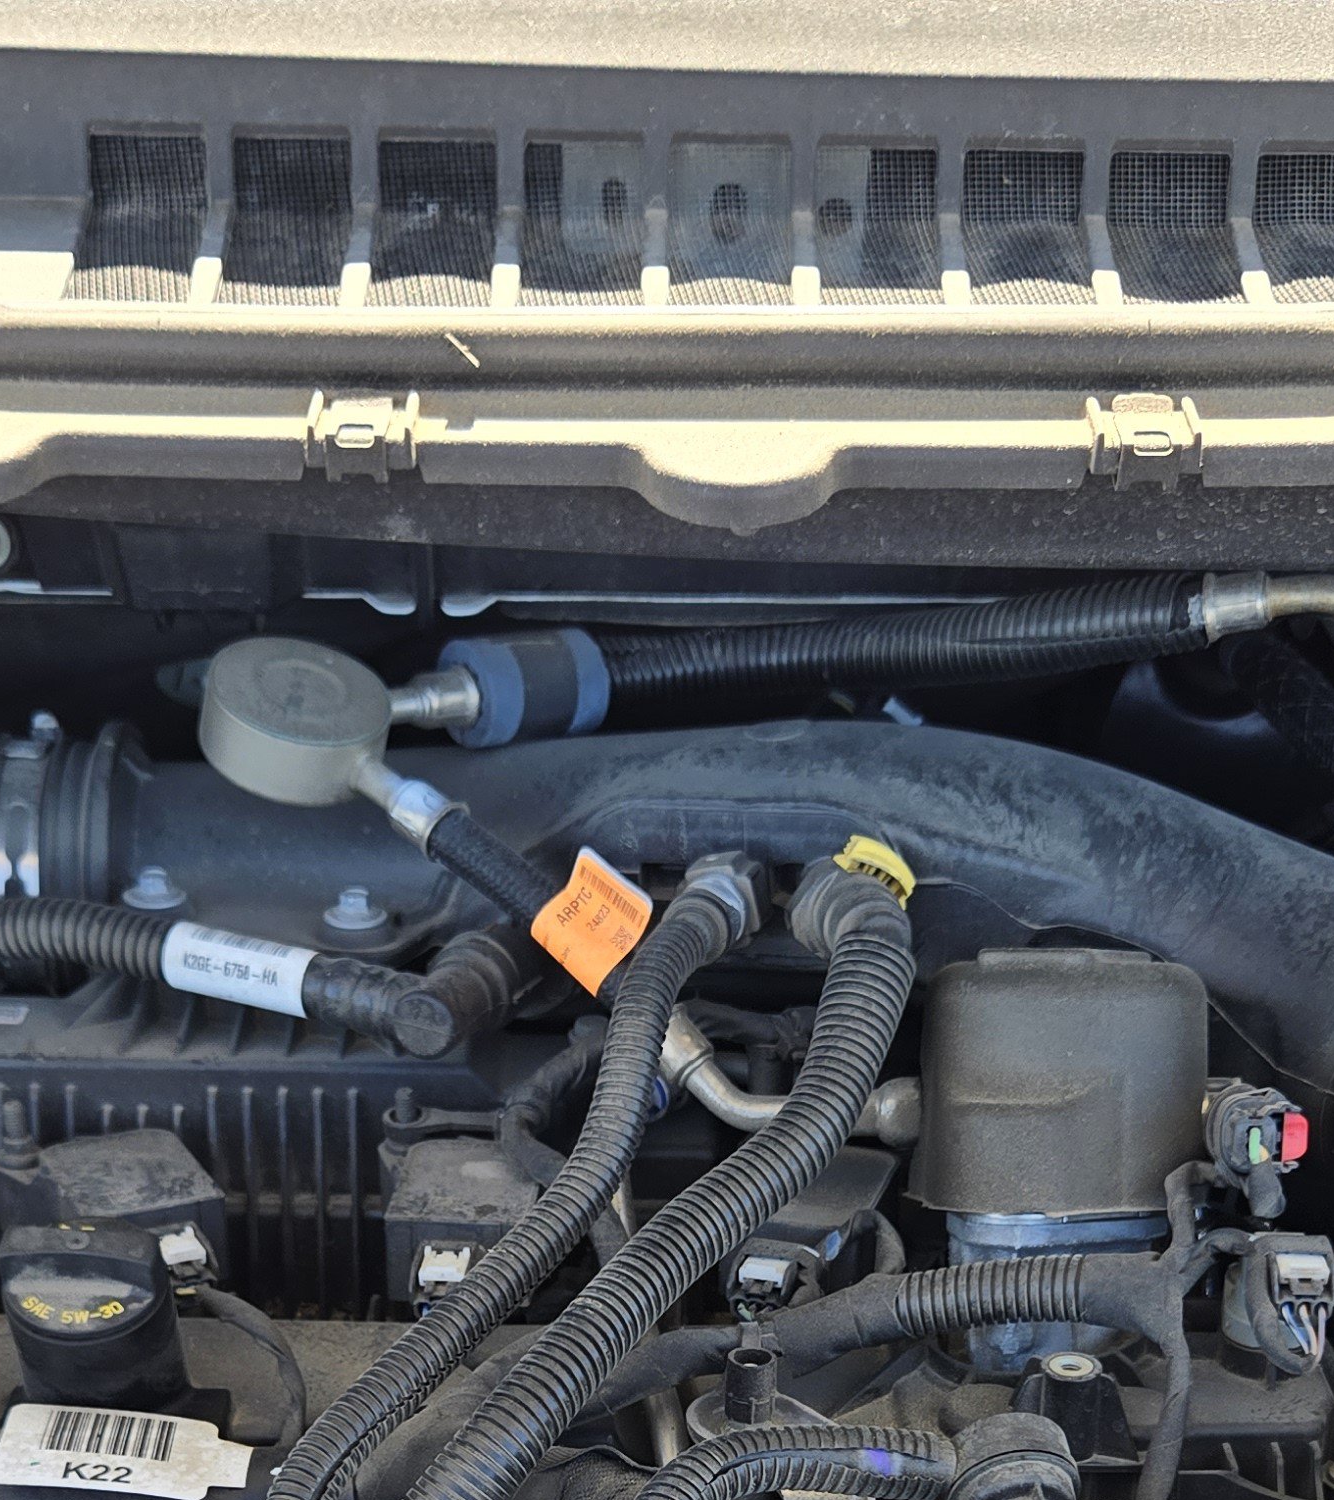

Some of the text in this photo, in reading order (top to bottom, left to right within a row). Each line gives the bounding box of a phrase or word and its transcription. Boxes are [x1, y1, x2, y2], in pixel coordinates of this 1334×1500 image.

[556, 887, 593, 927] ARPTC
[21, 1296, 125, 1324] SAE 5W-30
[62, 1462, 133, 1484] K22
